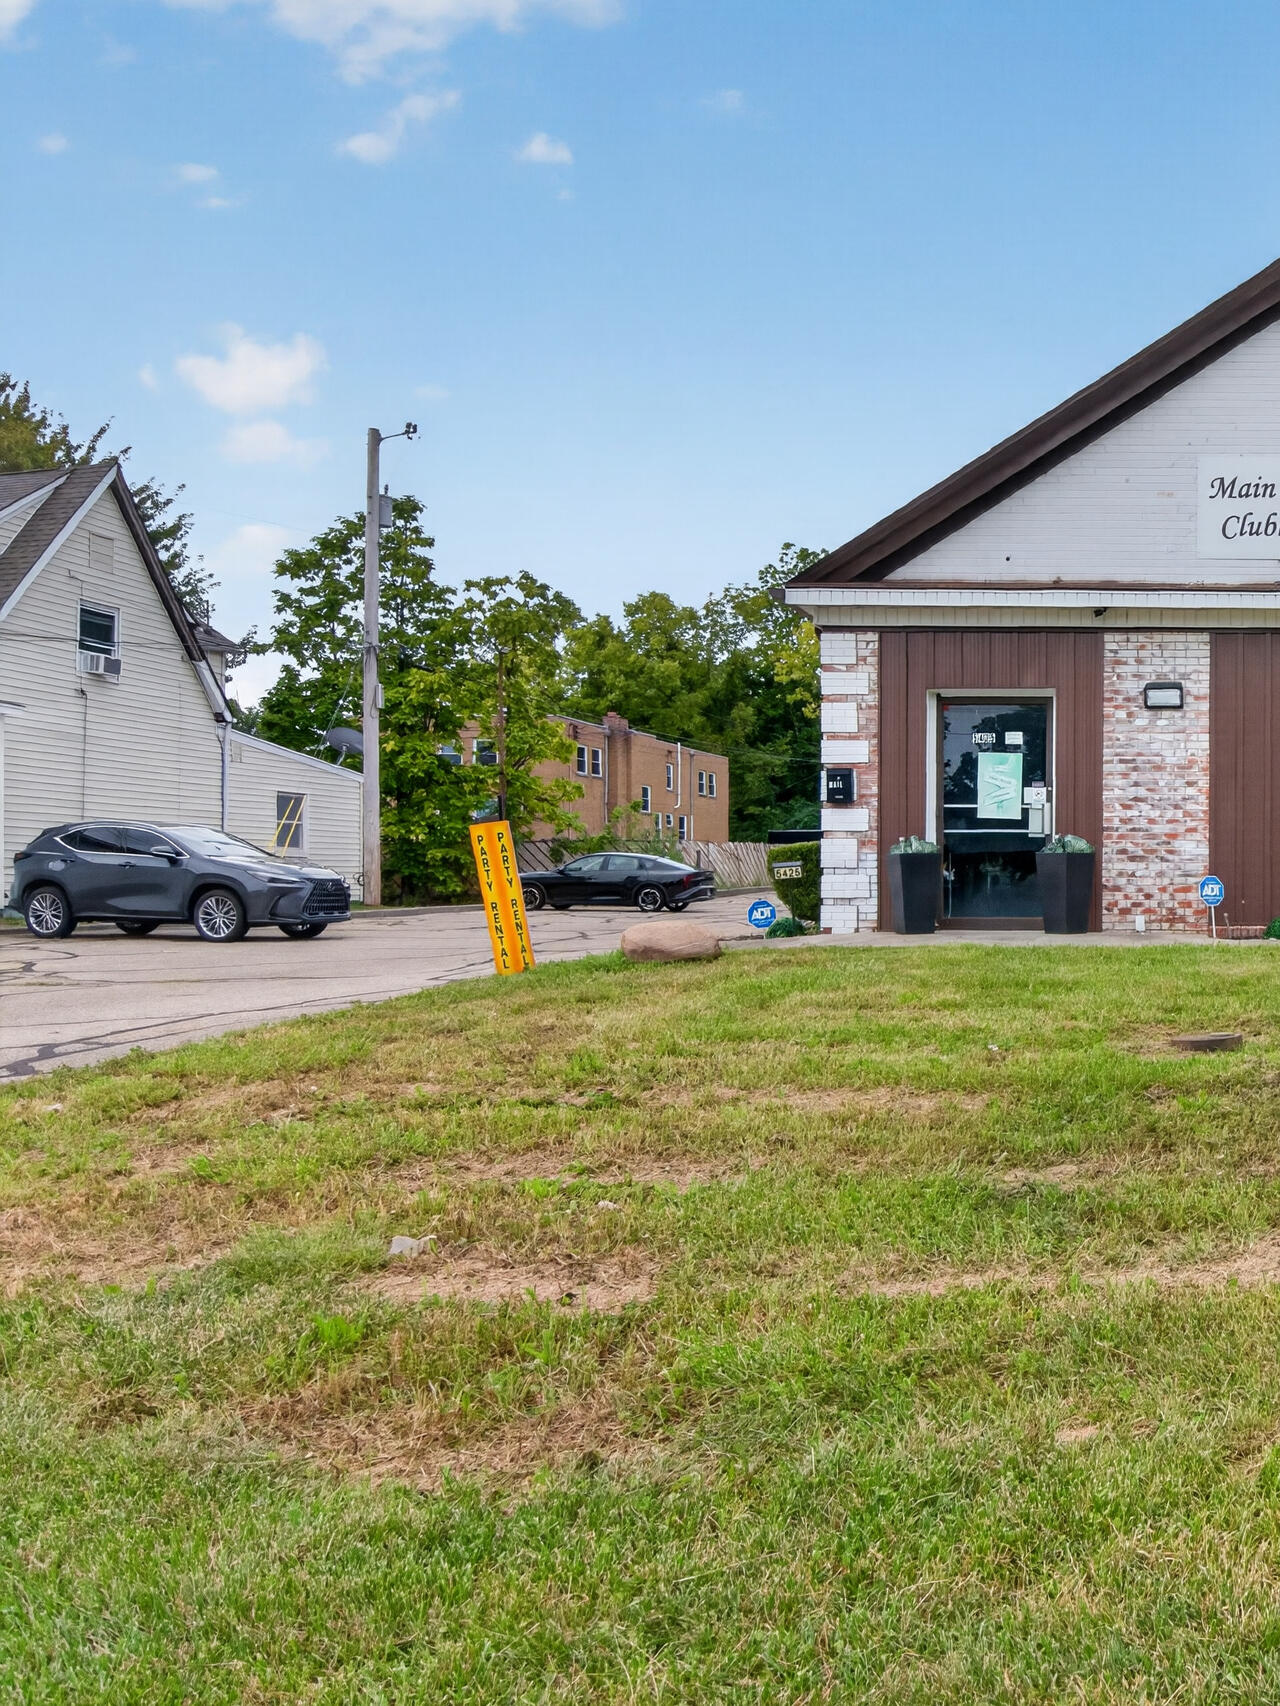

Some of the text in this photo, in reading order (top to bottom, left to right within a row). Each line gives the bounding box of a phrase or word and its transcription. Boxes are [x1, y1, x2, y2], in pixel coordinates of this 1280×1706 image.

[1209, 476, 1276, 499] Main
[775, 867, 801, 878] 5425
[497, 832, 529, 966] PARTY RENTAL
[1202, 884, 1221, 896] ADT
[477, 834, 510, 969] PARTY RENTAL
[751, 907, 773, 920] ADT
